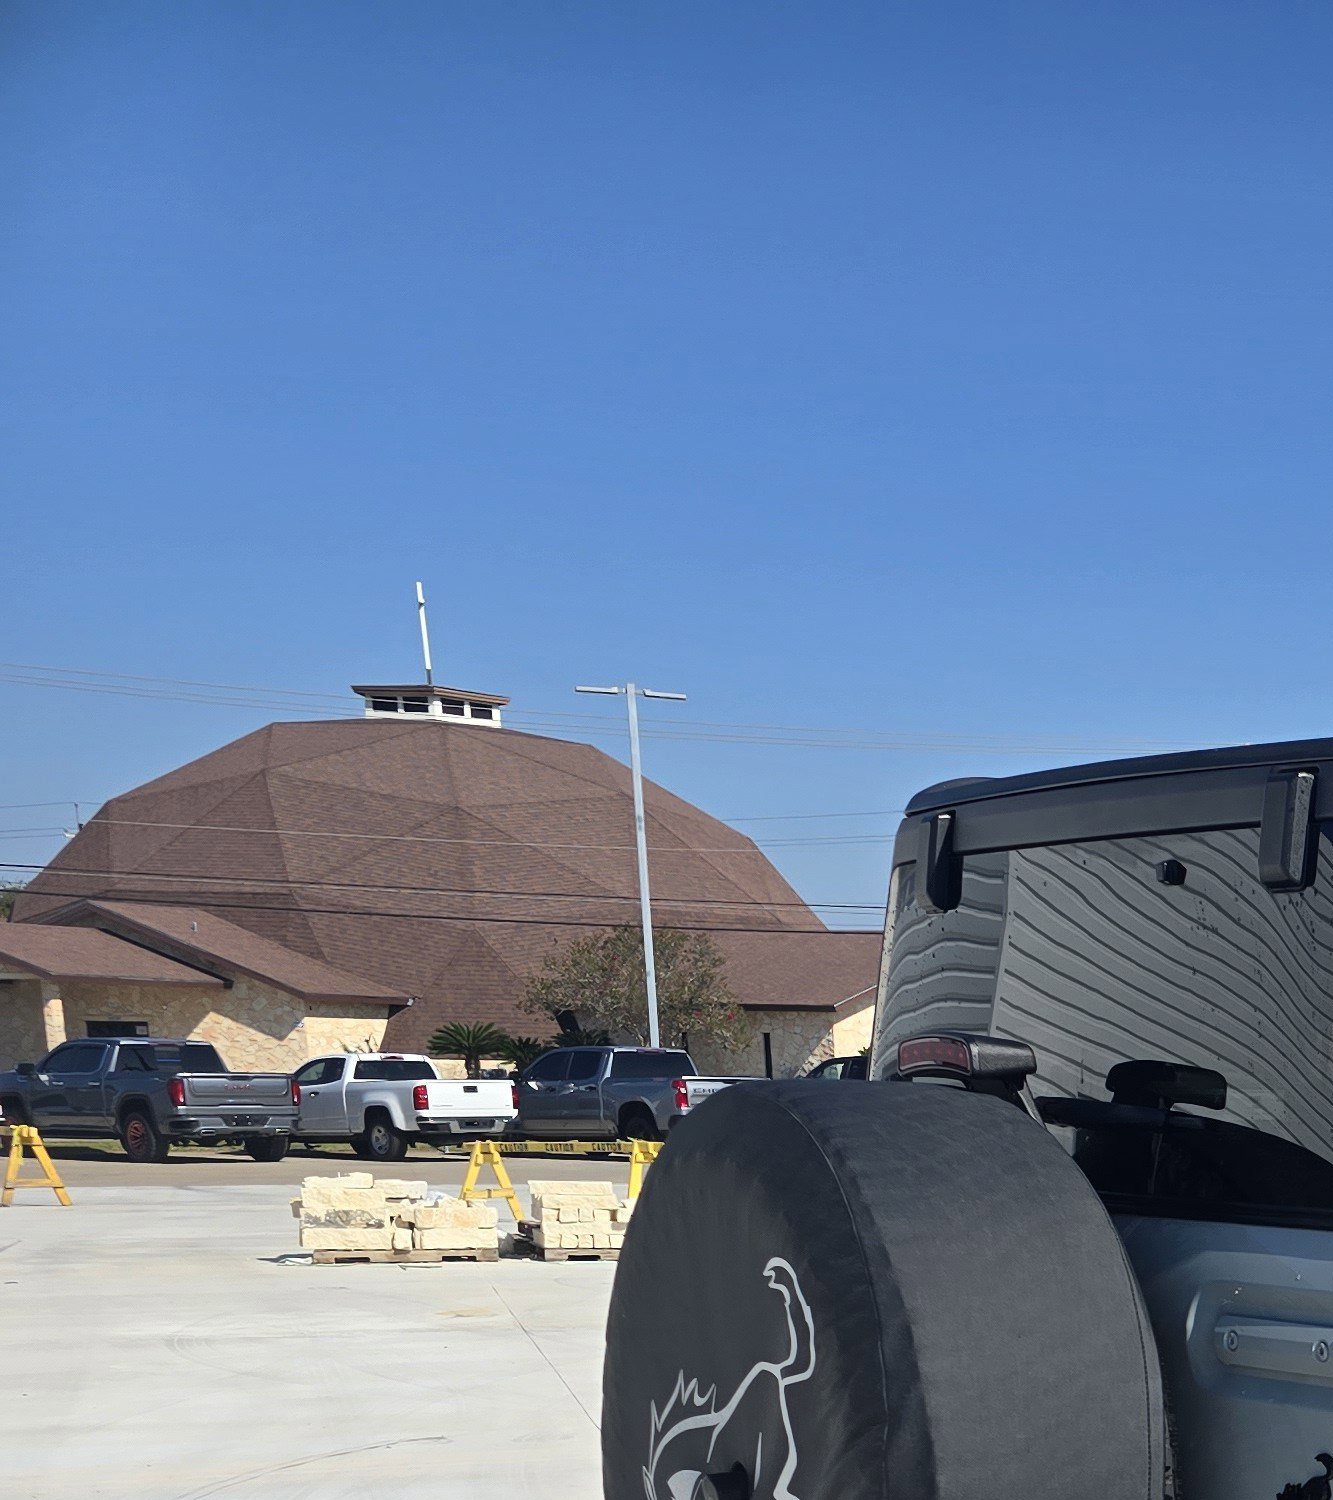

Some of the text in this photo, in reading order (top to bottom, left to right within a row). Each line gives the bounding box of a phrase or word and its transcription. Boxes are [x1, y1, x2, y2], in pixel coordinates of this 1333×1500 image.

[500, 1143, 621, 1151] CAUTION CAUTION CAUTION
